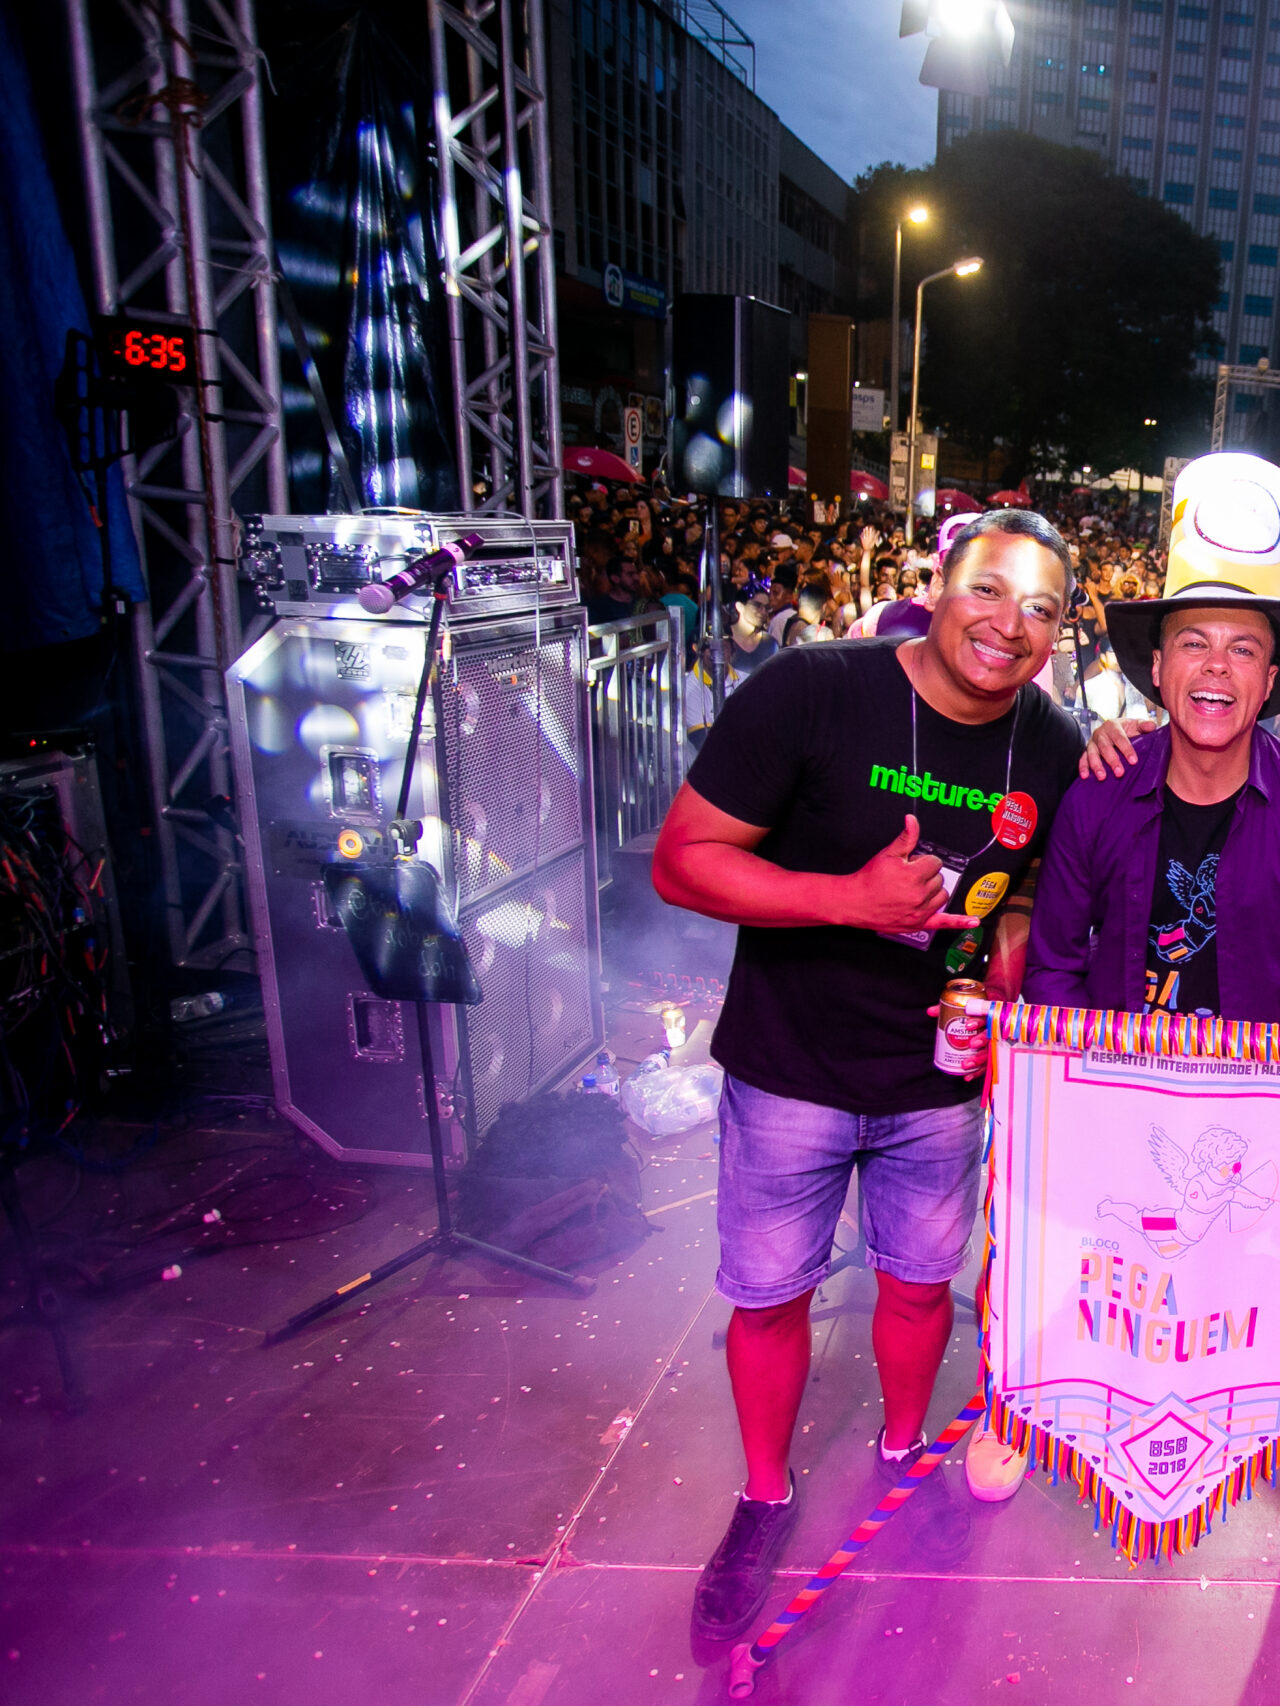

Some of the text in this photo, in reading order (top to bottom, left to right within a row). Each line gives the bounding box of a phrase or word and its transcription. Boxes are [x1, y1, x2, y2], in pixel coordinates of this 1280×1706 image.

[126, 331, 186, 371] 6:35
[1156, 1058, 1253, 1076] INTERATIVIDADE
[1081, 1237, 1120, 1250] BLOCO
[1080, 1252, 1178, 1315] PEGA
[1077, 1299, 1259, 1364] NINGUEM
[1149, 1436, 1188, 1457] BSB
[1148, 1458, 1186, 1475] 2018
